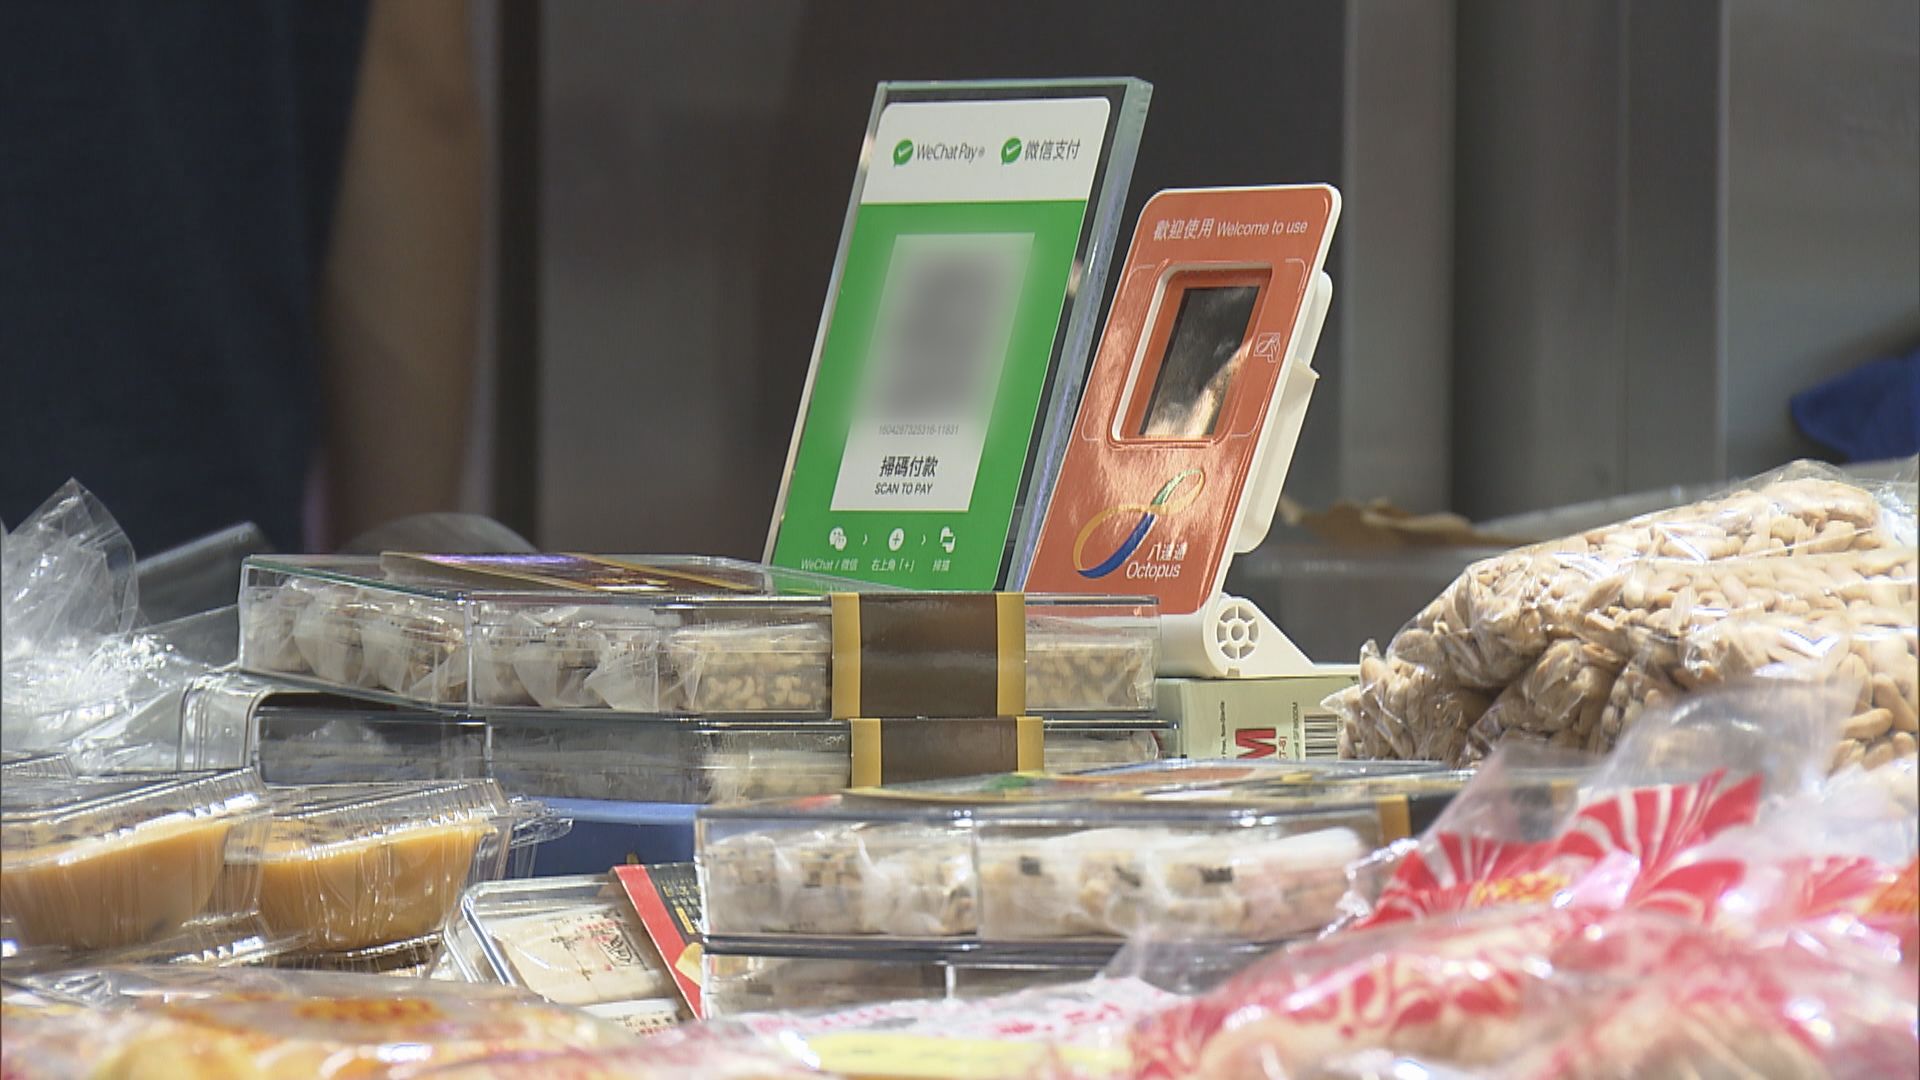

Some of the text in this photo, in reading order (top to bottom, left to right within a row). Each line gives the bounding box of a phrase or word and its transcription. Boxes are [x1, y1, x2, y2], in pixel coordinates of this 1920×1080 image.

[916, 141, 957, 161] WeChat
[1024, 138, 1081, 162] 微信支付
[1153, 217, 1309, 241] 歡迎使用 Welcome to use
[878, 455, 939, 478] 掃碼付款
[874, 482, 934, 495] SCAN TO PAY
[800, 558, 834, 571] WeChat
[1125, 561, 1182, 583] Octopus
